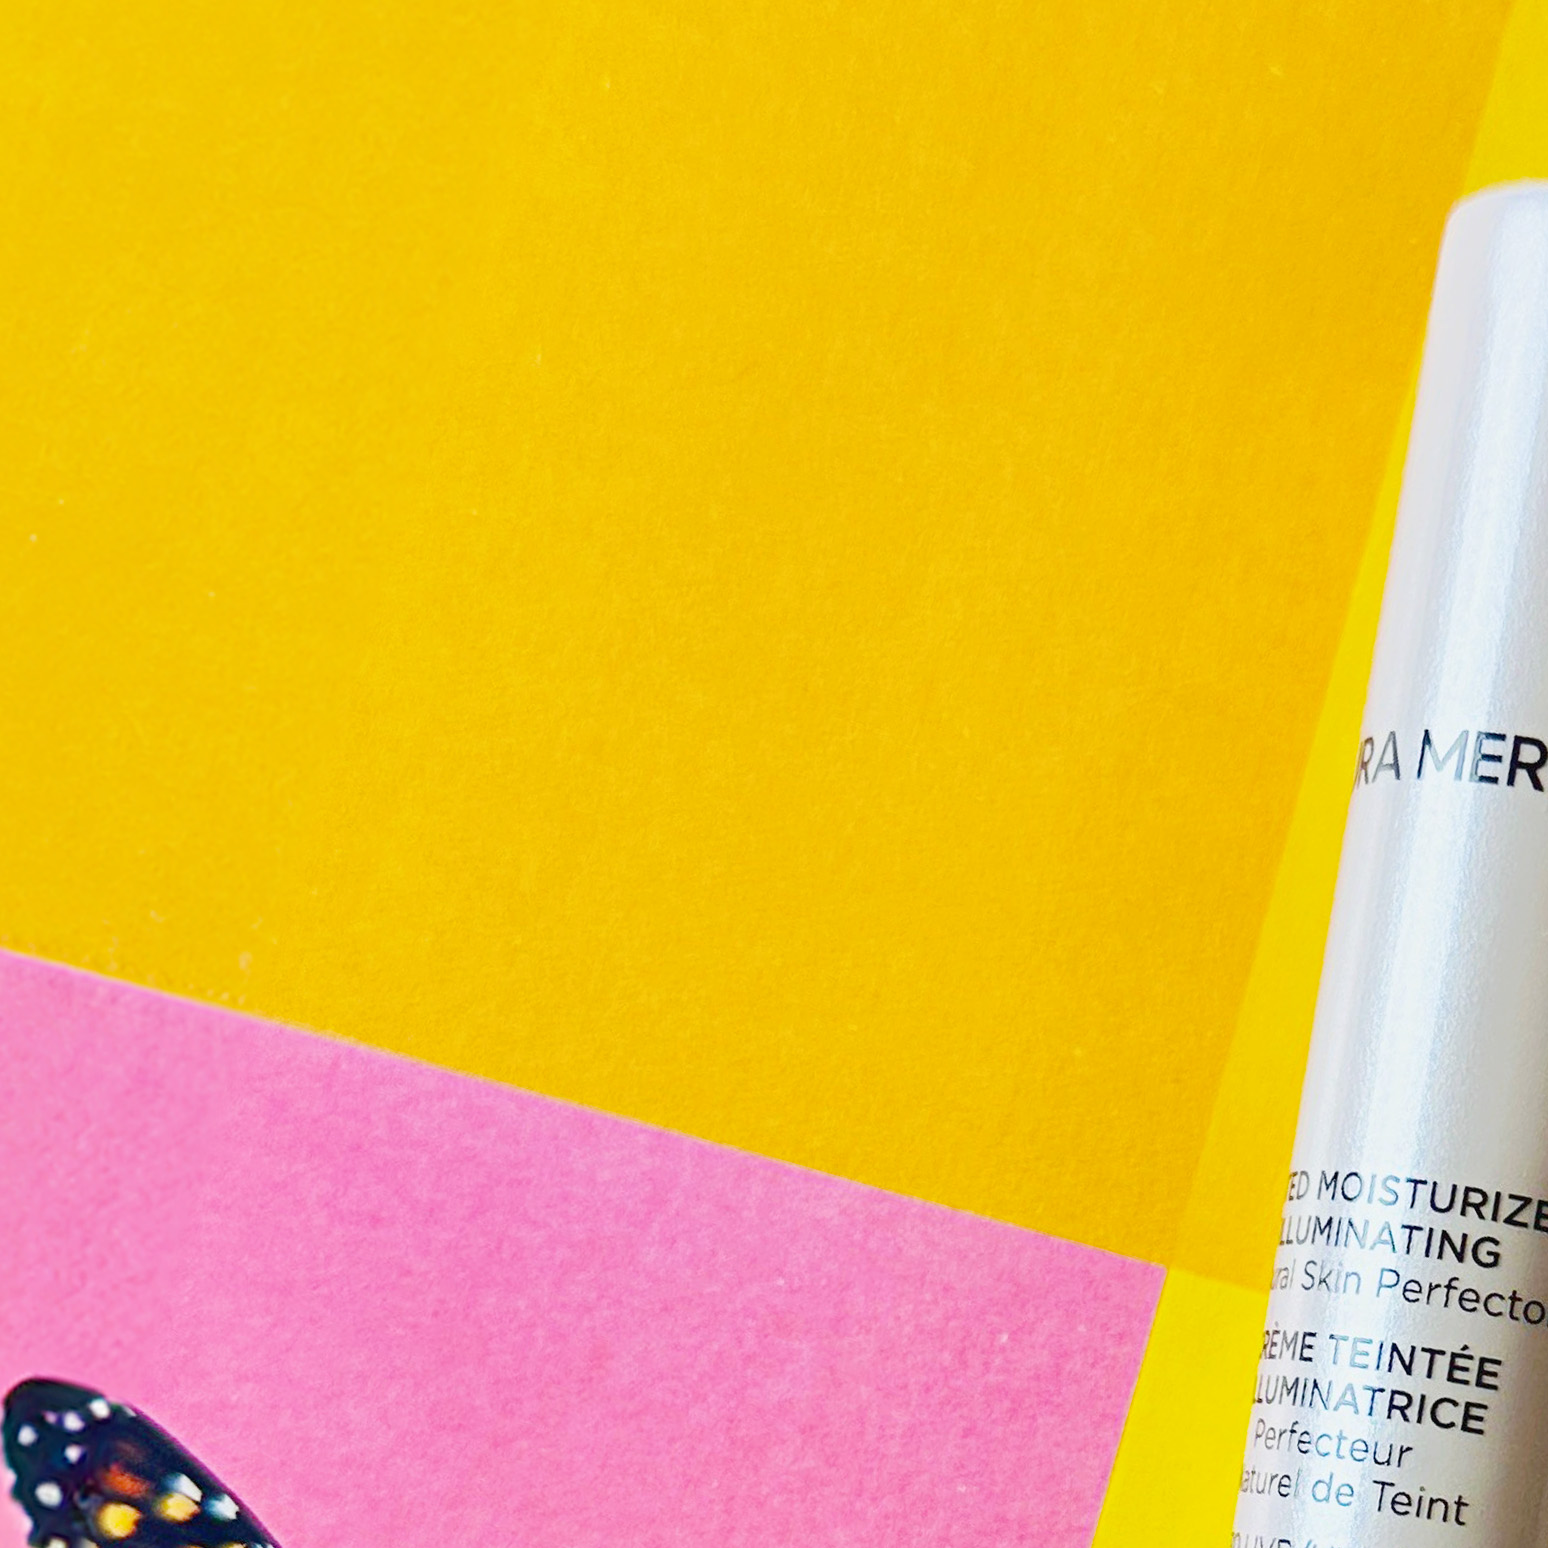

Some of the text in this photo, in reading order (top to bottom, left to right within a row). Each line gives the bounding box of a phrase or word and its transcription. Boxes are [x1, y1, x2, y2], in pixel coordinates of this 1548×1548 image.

[1301, 1259, 1362, 1295] Skin
[1328, 1333, 1503, 1391] TEINTÉE
[1253, 1417, 1413, 1469] Perfecteur
[1311, 1471, 1355, 1508] de
[1372, 1480, 1470, 1527] Teint
